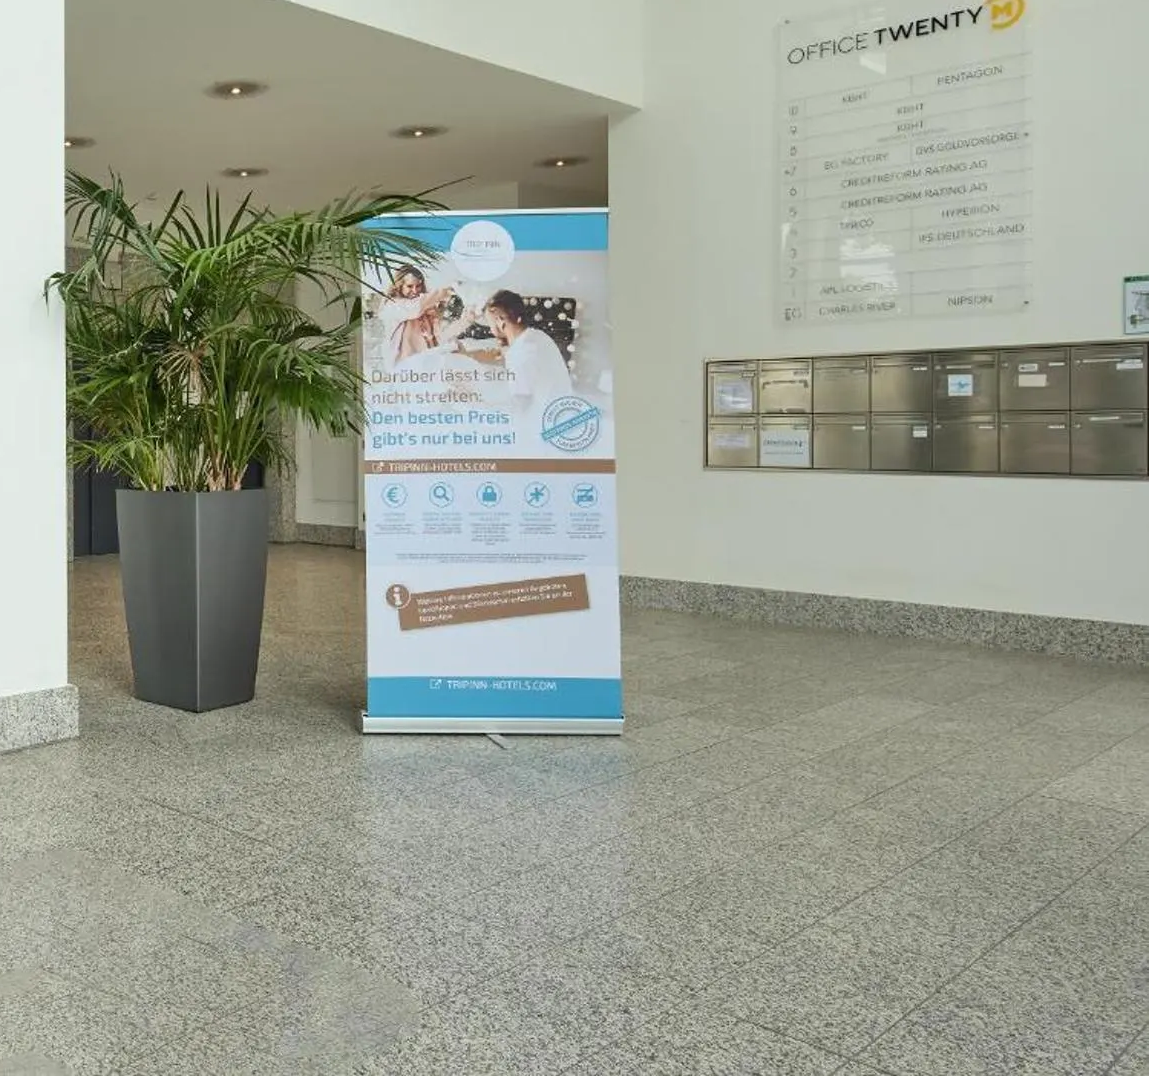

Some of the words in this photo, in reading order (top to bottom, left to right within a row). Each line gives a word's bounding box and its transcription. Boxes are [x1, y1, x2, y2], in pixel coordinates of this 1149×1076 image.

[787, 32, 869, 65] OFFICE
[873, 5, 983, 45] TWENTY
[937, 65, 1003, 84] PENTAGON
[937, 223, 1025, 242] DEUTSCHLAND
[371, 369, 436, 383] Darüber
[440, 368, 479, 382] lässt
[484, 369, 516, 382] sich
[371, 390, 412, 404] nicht
[415, 389, 483, 404] streiten:
[372, 411, 404, 425] Den
[408, 411, 464, 425] besten
[468, 410, 510, 424] Preis
[422, 434, 450, 445] nur
[453, 431, 477, 444] bei
[482, 432, 516, 444] uns!
